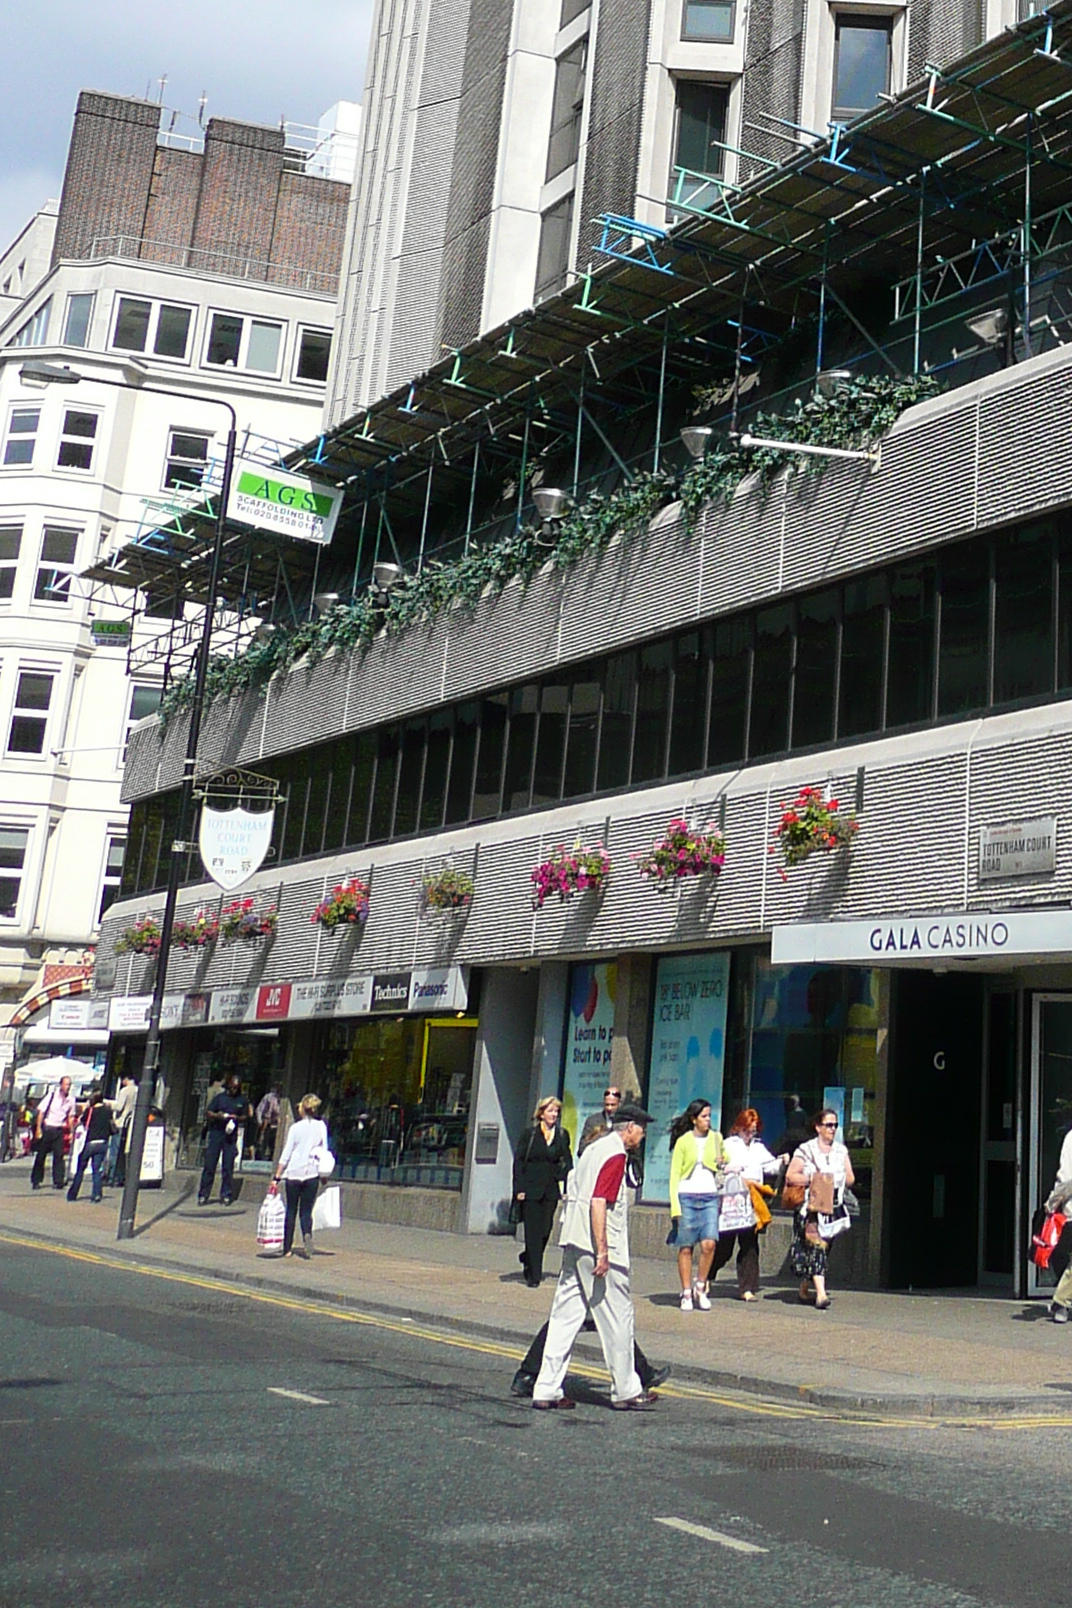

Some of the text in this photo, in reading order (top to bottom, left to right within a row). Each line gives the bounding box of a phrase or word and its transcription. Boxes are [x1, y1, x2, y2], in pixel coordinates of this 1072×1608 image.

[254, 479, 318, 513] AGS
[237, 494, 305, 520] SCAFFOLDING
[207, 819, 267, 831] TOTTENHAM
[217, 832, 252, 843] COURT
[983, 835, 1052, 857] TOTTENHAM COURT
[220, 845, 249, 856] ROAD
[982, 857, 1001, 872] ROAD
[870, 922, 1009, 951] GALA CASINO
[265, 987, 282, 1007] JVC
[345, 980, 366, 996] STORE
[374, 982, 408, 1001] Technics
[413, 980, 448, 998] Panasonic
[700, 979, 723, 998] ZERO
[674, 1003, 690, 1021] BAR
[574, 1026, 596, 1042] Learn
[598, 1025, 607, 1040] to
[573, 1047, 592, 1064] Start
[593, 1047, 601, 1063] to
[933, 1051, 946, 1070] G
